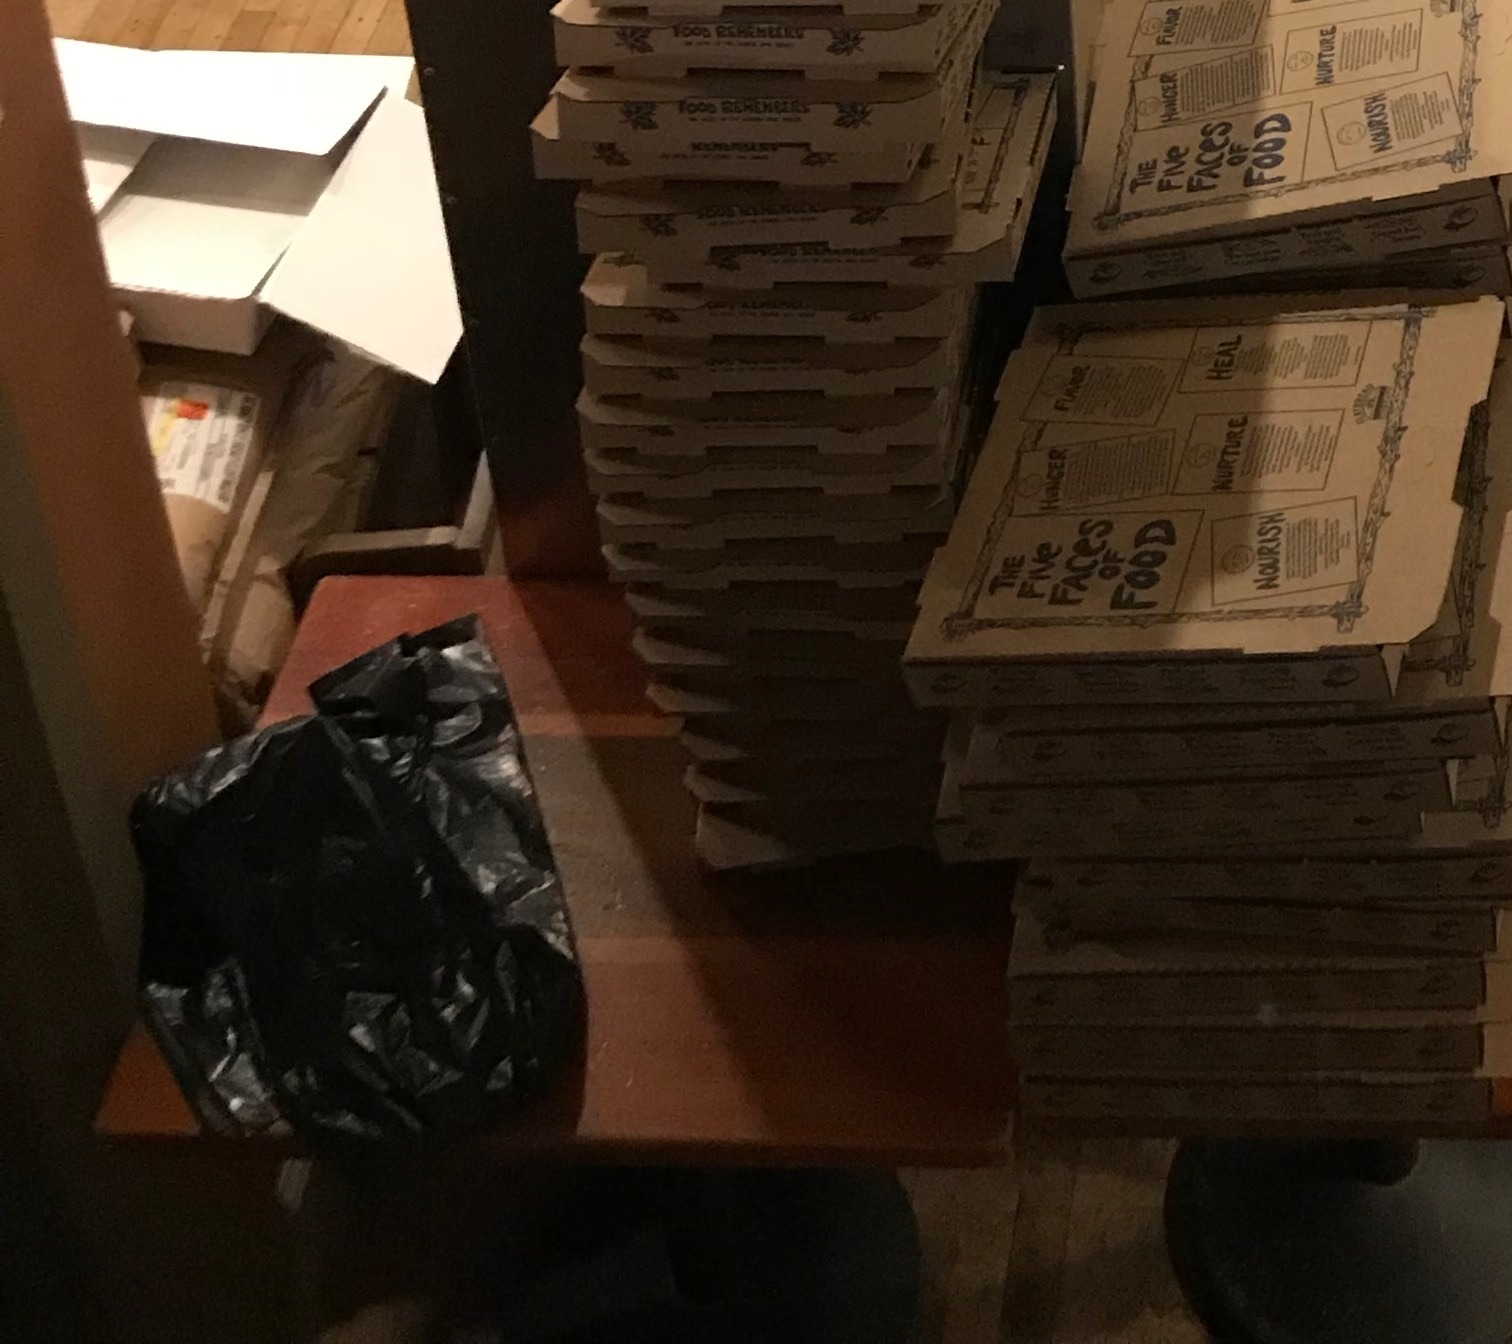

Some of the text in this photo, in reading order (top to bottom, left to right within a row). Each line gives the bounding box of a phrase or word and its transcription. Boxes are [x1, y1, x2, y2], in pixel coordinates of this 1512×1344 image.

[1155, 5, 1183, 46] FLAVOR
[1315, 24, 1338, 86] NURTURE
[1159, 72, 1181, 124] HUNGER
[1363, 91, 1394, 154] NOURISH
[1129, 158, 1158, 194] THE
[1226, 142, 1251, 167] OF
[1243, 113, 1292, 188] FOOD
[1205, 334, 1243, 381] HEAL
[1053, 364, 1092, 413] FLAVOR
[1211, 414, 1249, 492] NURTURE
[1041, 448, 1069, 511] HUNGER
[988, 553, 1026, 597] THE
[1098, 548, 1127, 580] OF
[1109, 518, 1177, 611] FOOD
[1253, 511, 1286, 590] NOURISH
